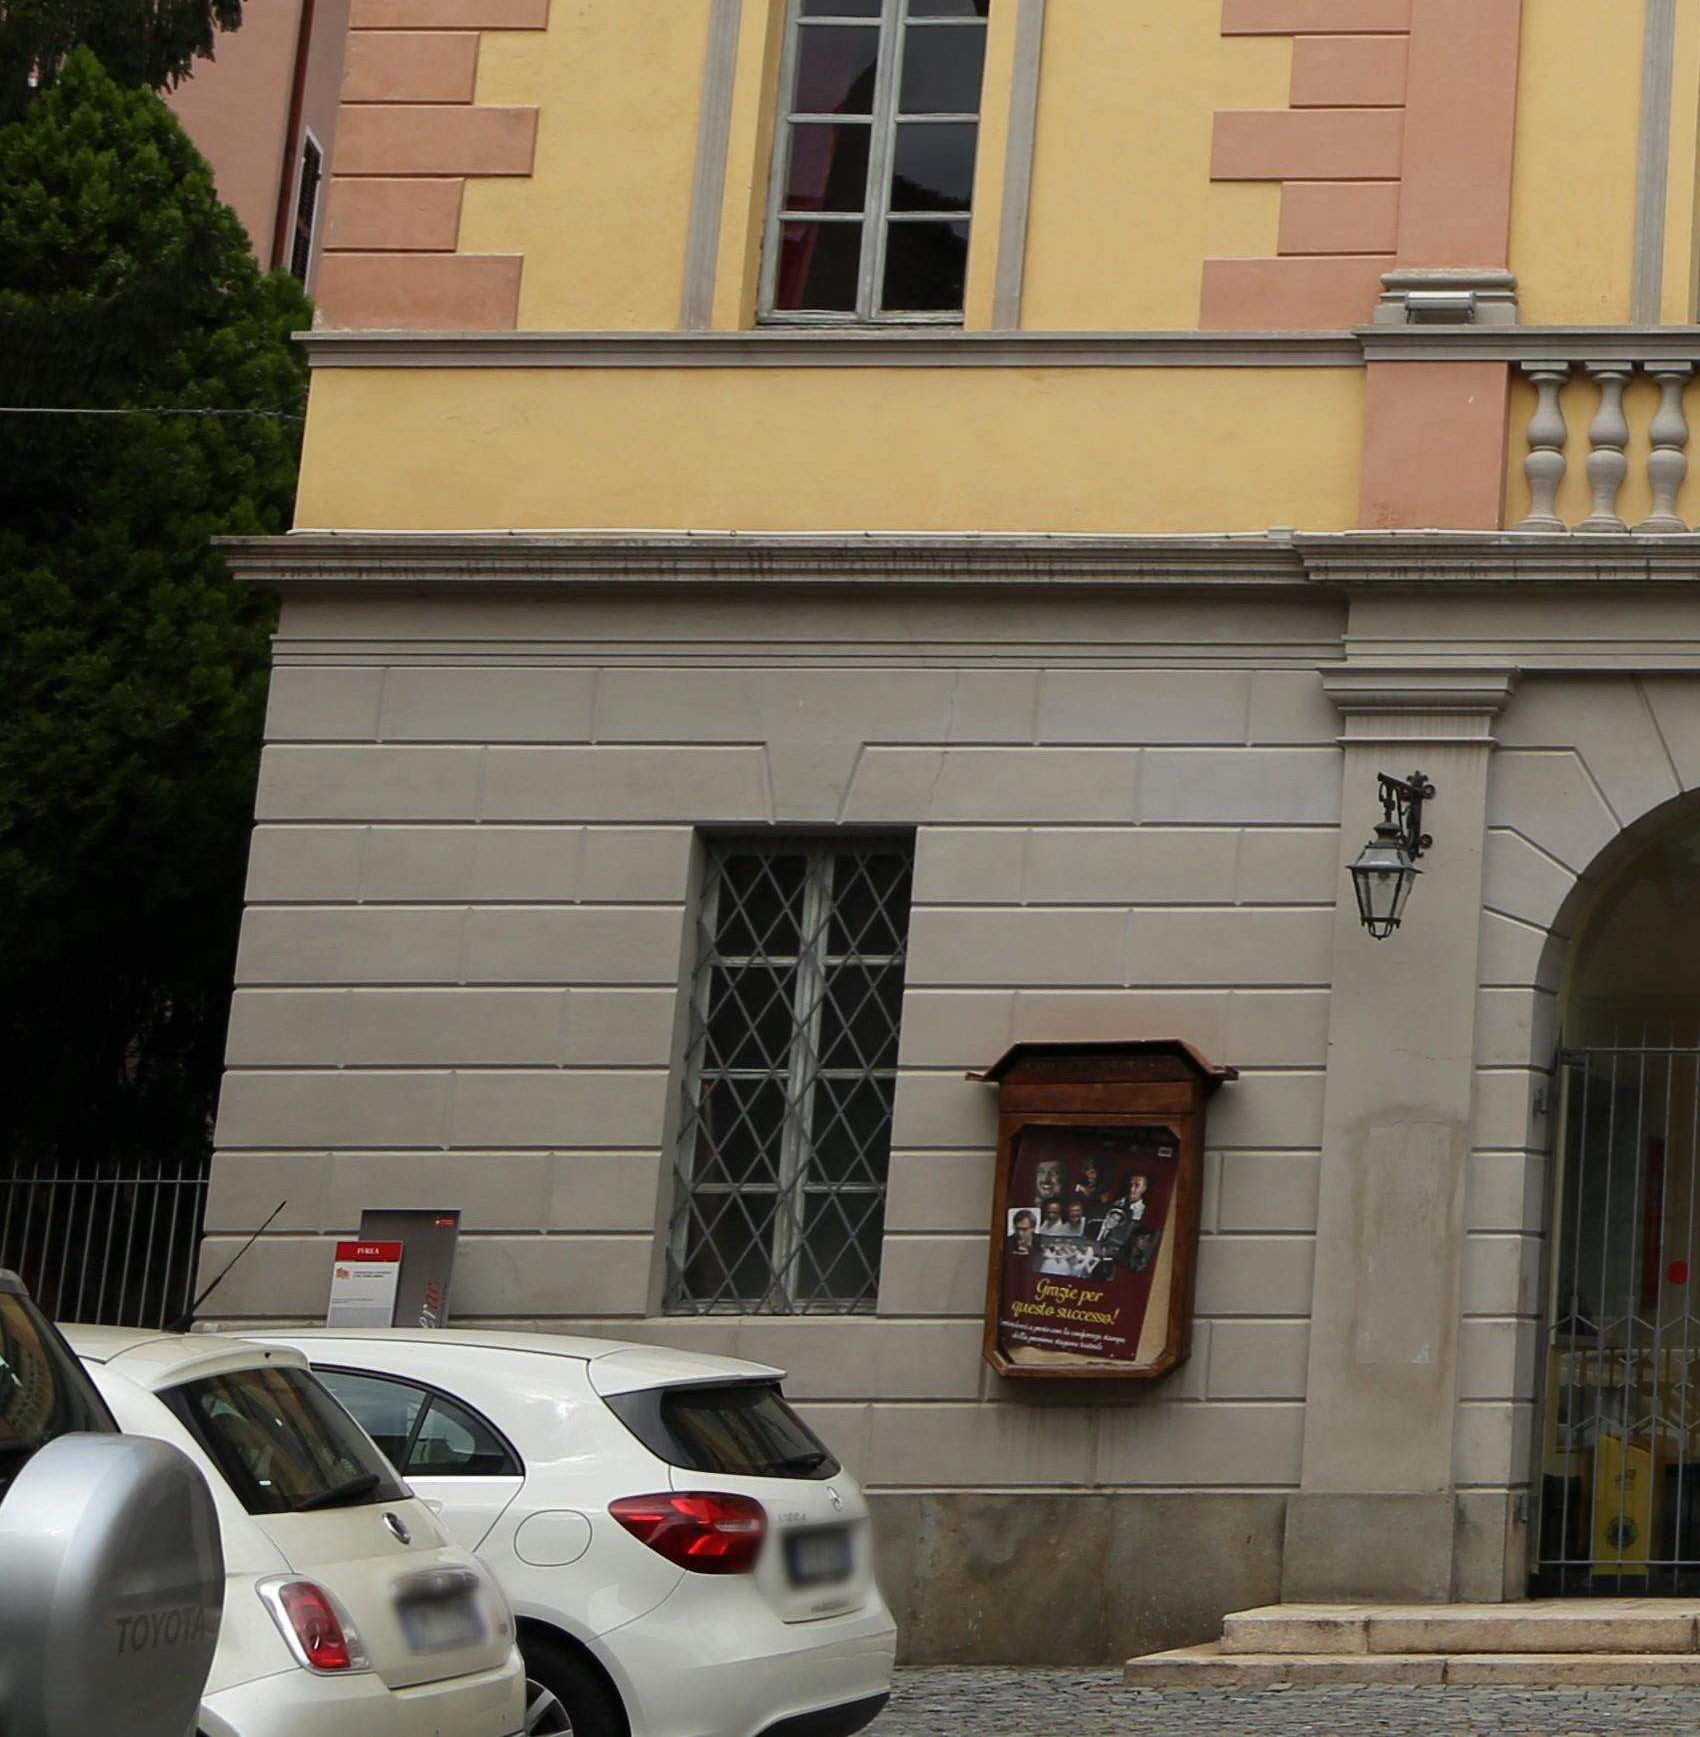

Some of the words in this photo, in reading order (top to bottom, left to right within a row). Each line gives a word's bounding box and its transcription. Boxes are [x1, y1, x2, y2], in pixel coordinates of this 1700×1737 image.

[1034, 1278, 1078, 1303] Grazie
[1077, 1289, 1104, 1306] per
[1011, 1300, 1055, 1318] questo
[1056, 1307, 1120, 1325] successo!
[115, 1606, 205, 1654] TOYOTA
